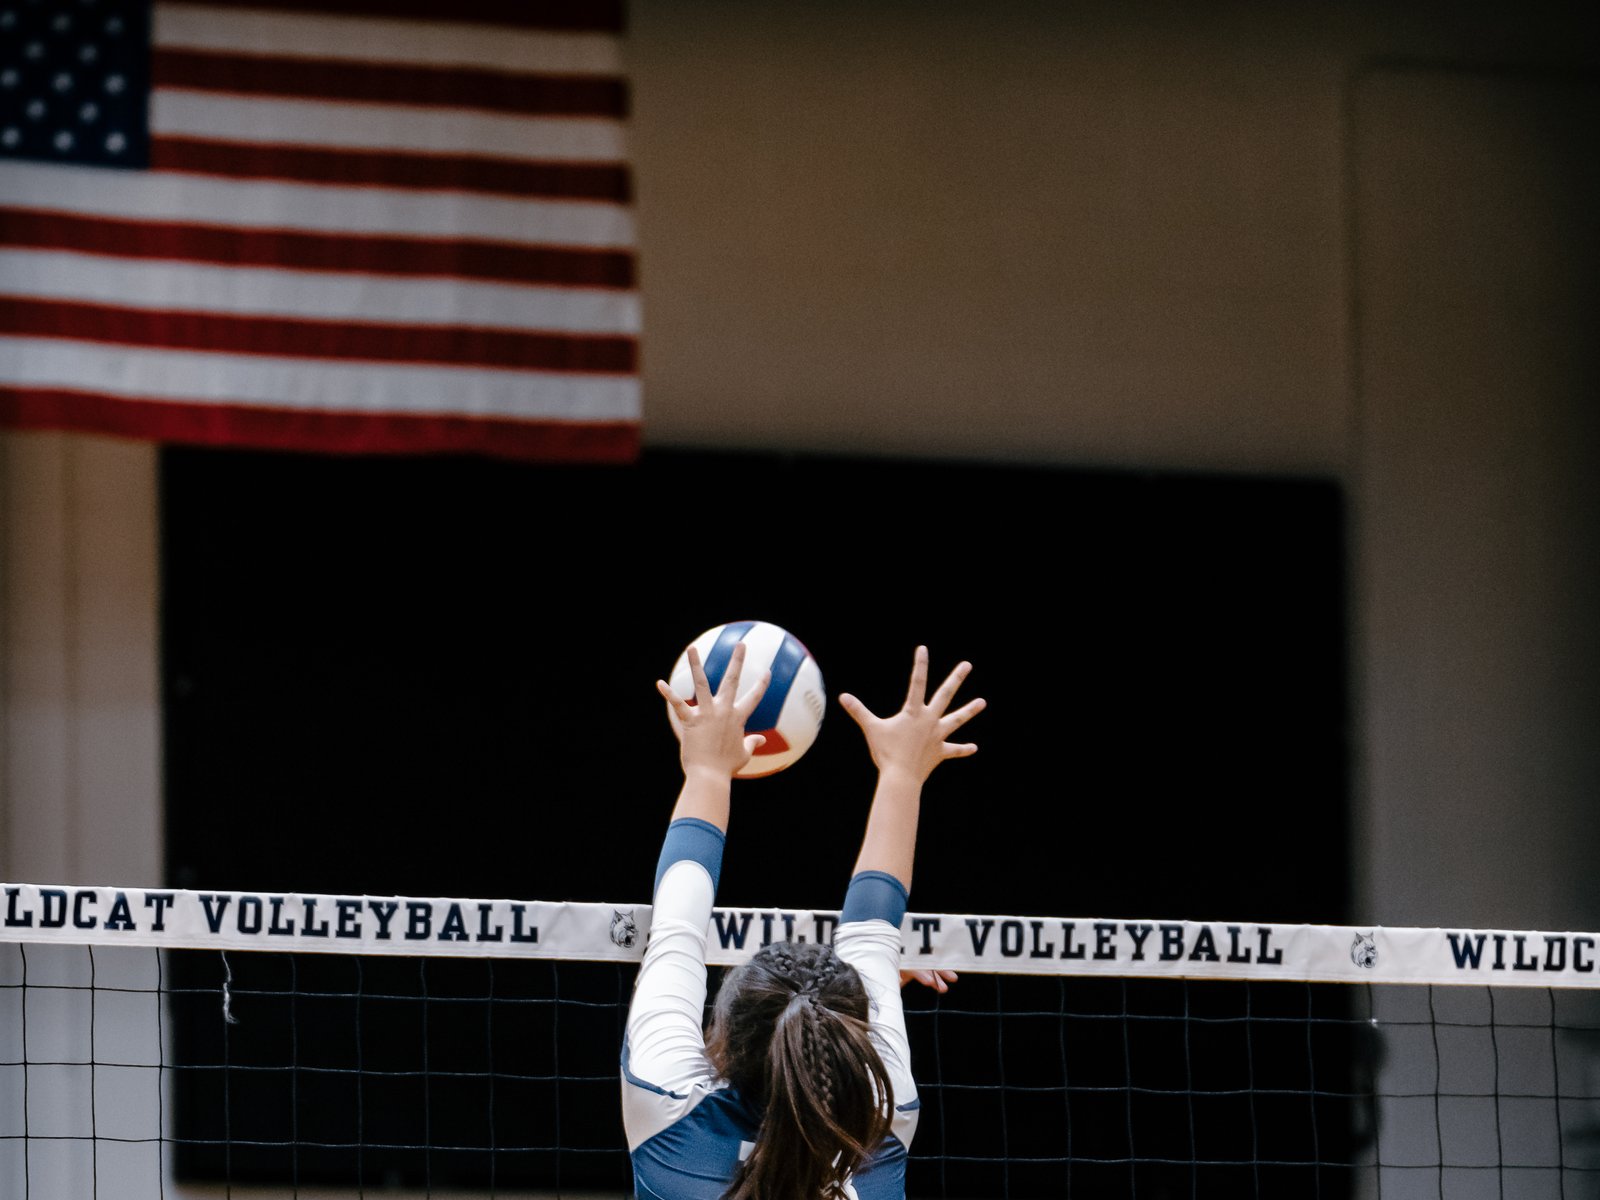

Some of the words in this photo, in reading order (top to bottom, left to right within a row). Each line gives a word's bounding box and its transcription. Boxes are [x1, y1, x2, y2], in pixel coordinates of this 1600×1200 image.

[4, 888, 175, 931] LDCAT
[199, 894, 538, 943] VOLLEYBALL
[712, 912, 941, 955] WILDT
[965, 918, 1283, 965] VOLLEYBALL
[1447, 933, 1600, 972] WILDC
